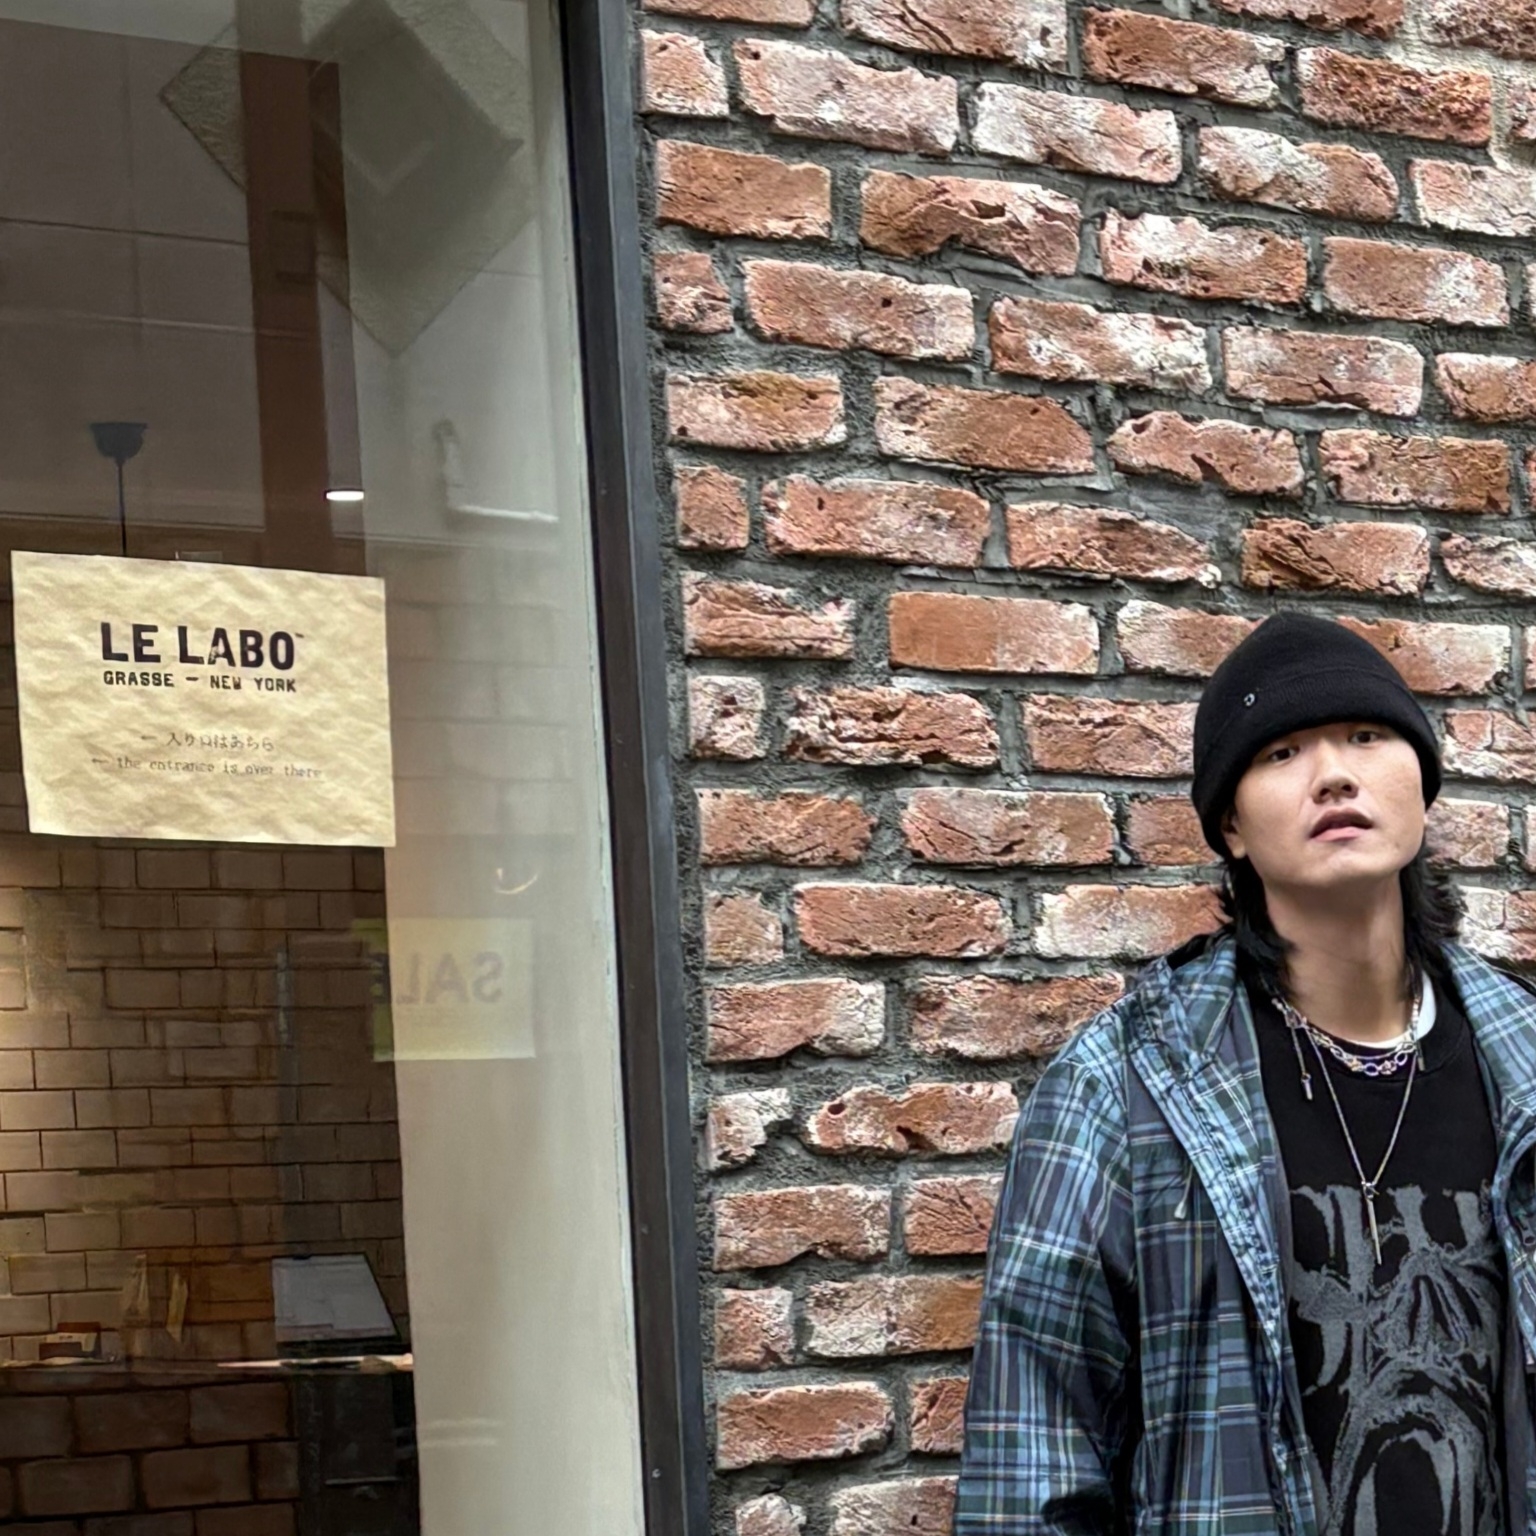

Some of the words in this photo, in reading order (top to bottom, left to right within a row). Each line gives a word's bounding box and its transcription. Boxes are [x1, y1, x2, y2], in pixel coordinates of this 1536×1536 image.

[100, 622, 162, 663] LE
[176, 625, 296, 671] LABO
[103, 671, 175, 688] GRASSE
[209, 675, 242, 690] NEW
[254, 677, 297, 693] YORK
[116, 756, 141, 770] the
[224, 761, 238, 775] is
